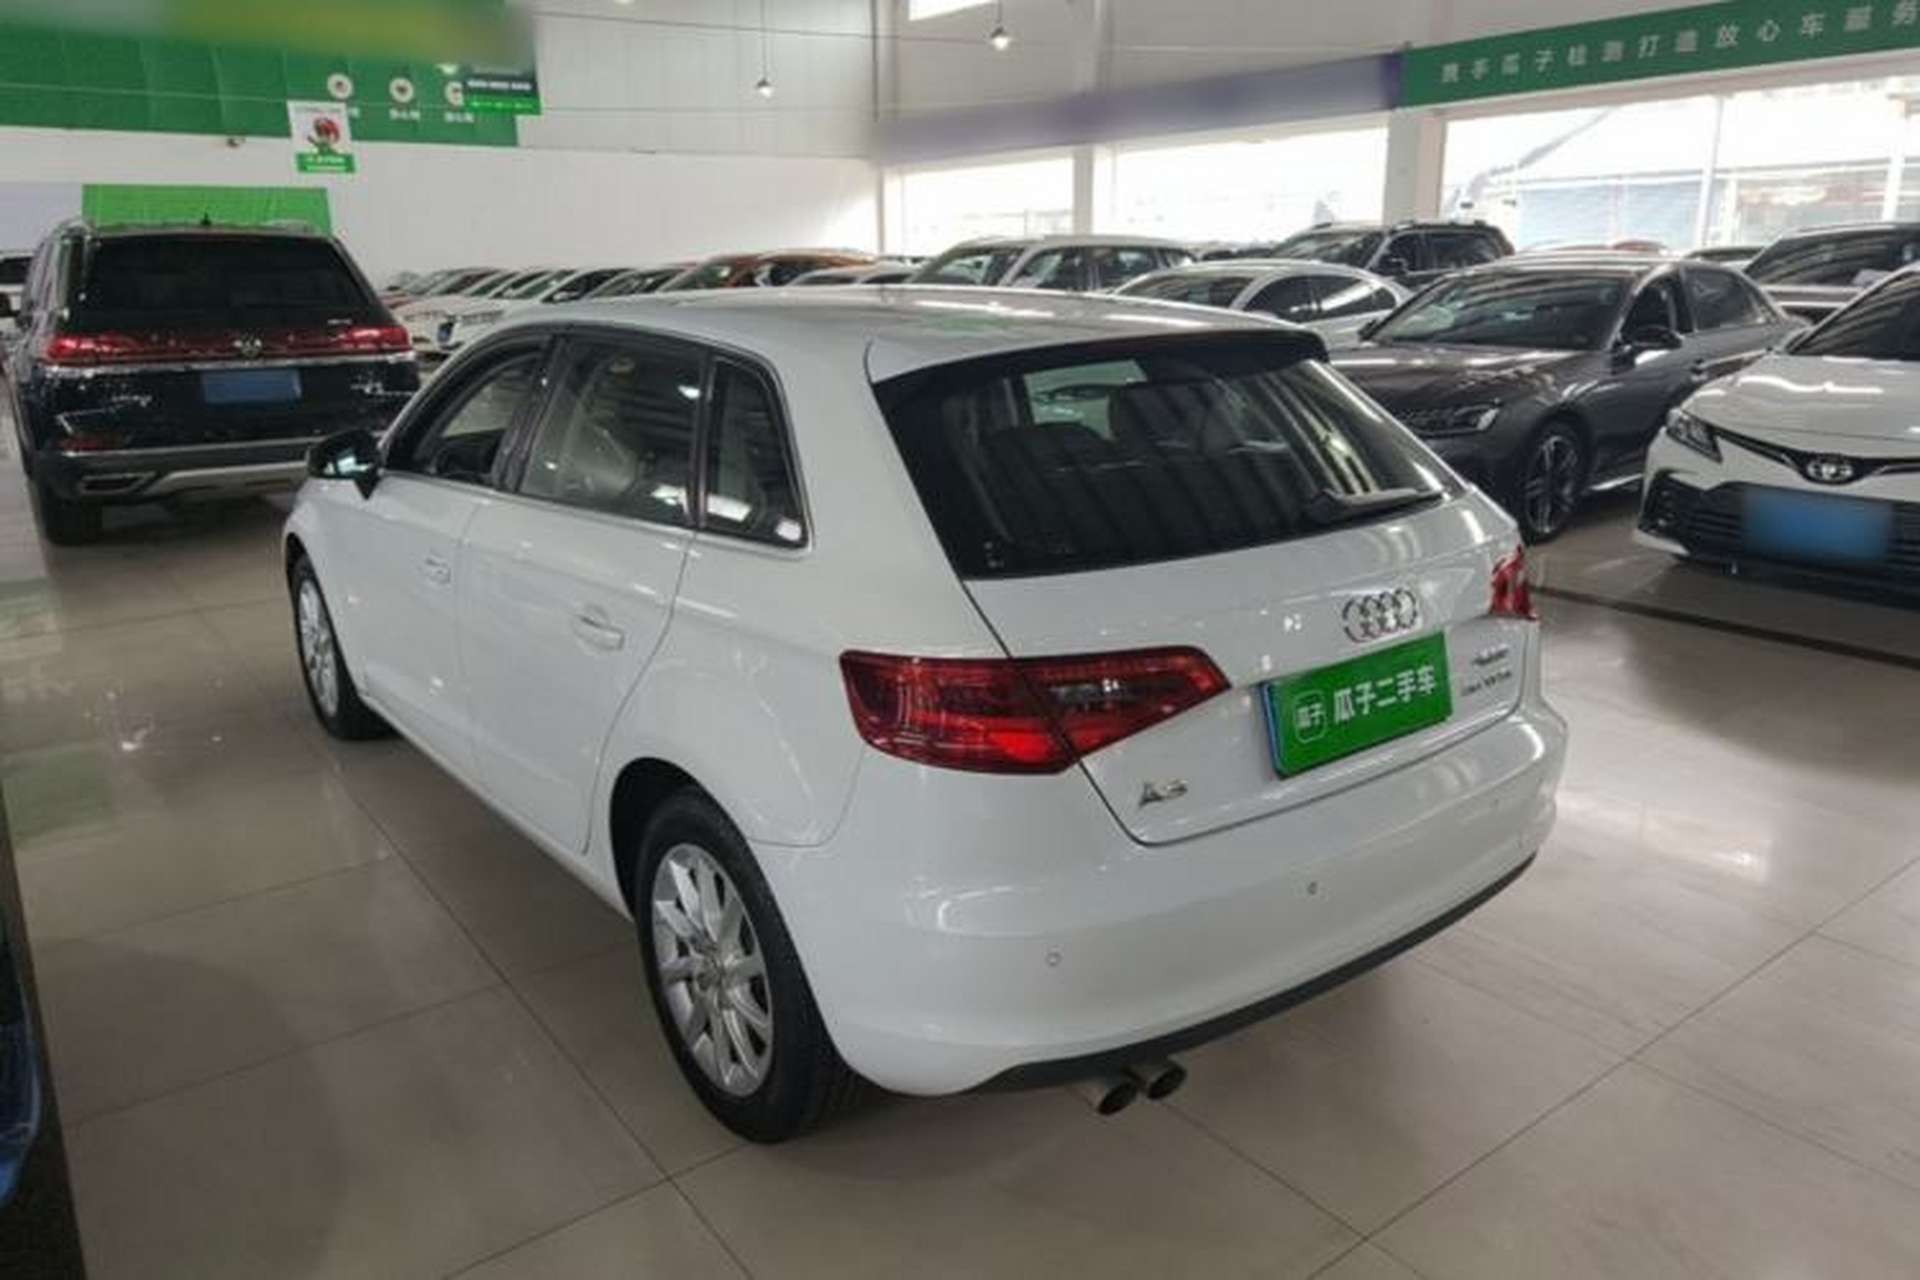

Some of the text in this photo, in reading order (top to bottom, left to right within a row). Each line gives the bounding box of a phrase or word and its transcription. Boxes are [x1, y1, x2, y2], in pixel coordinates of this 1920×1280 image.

[1333, 665, 1438, 724] 瓜子二手车
